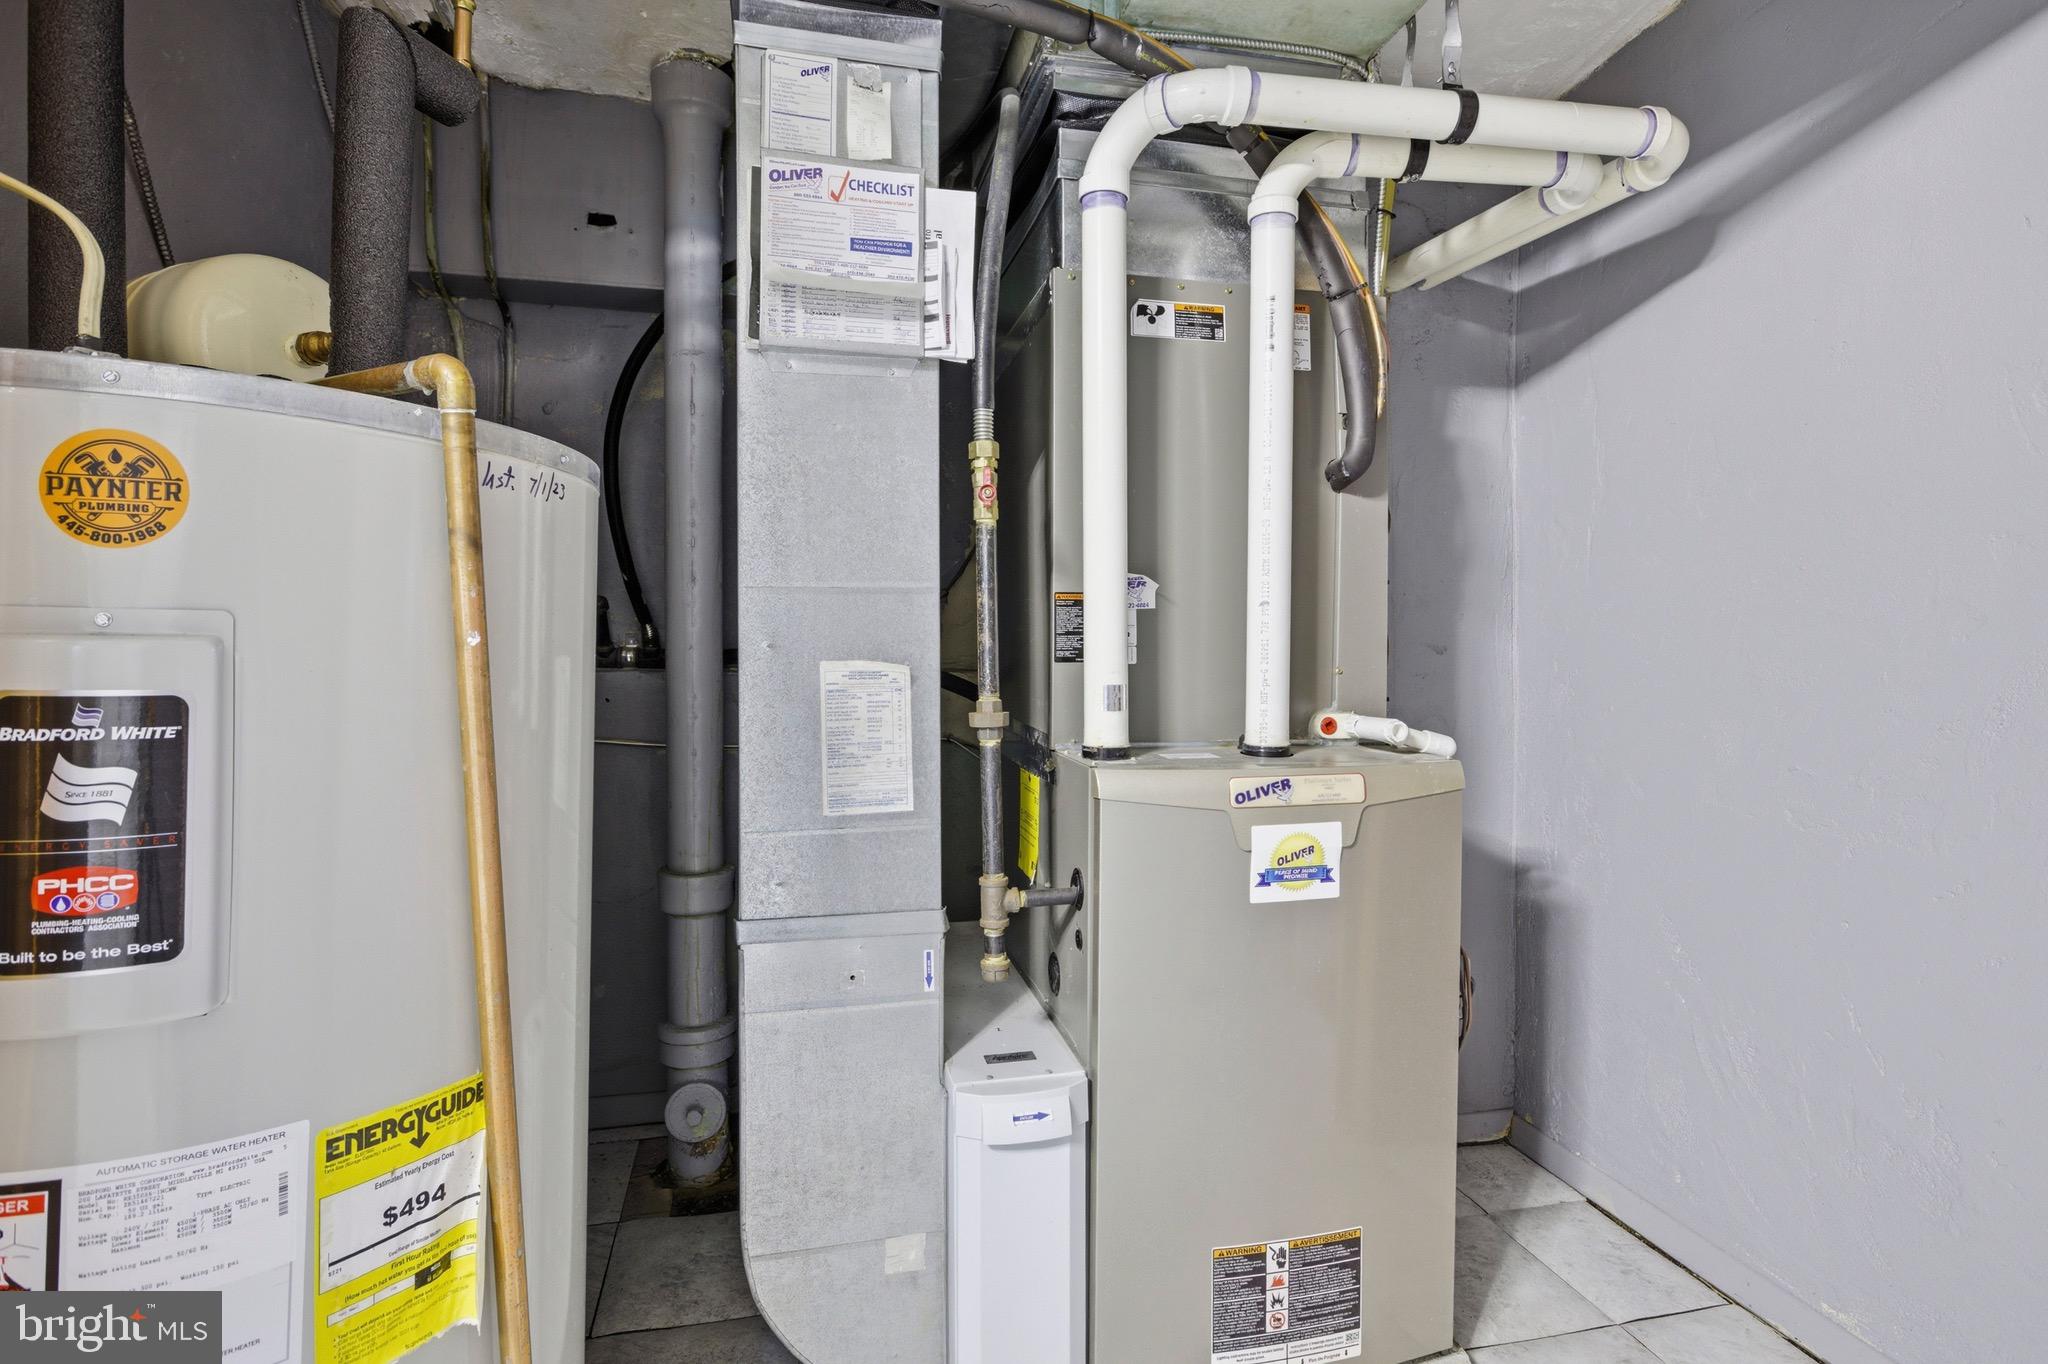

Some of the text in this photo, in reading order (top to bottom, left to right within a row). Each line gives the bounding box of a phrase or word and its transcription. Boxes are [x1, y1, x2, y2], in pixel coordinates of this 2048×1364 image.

[800, 65, 830, 77] OLIVER
[768, 167, 915, 197] OLIVER CHECKLIST
[45, 474, 182, 502] PAYNTER
[530, 472, 565, 502] 7/1/23
[79, 501, 150, 513] PLUMBING
[57, 514, 167, 544] 445-800-1968
[0, 726, 178, 742] BRADFORD WHITE
[91, 790, 114, 798] 1881
[1235, 778, 1292, 805] OLIVER
[1277, 845, 1315, 866] OLIVER
[38, 874, 135, 895] PHCC
[31, 914, 140, 928] PLUMBING-HEATING-COOLING
[31, 921, 137, 936] CONTRACTORS ASSOCIATION
[0, 940, 170, 964] Built to be the Best
[325, 1081, 484, 1162] ENERGYGUIDE
[96, 1130, 286, 1176] AUTOMATIC STORAGE WATER HEATER
[375, 1150, 455, 1190] Estimated Yearly Energy Cost
[382, 1183, 446, 1228] $494
[1225, 1230, 1358, 1256] WARNING AVERTISSEMENT
[391, 1258, 405, 1270] First
[406, 1250, 422, 1263] Hour
[388, 1272, 404, 1283] water
[405, 1266, 416, 1276] you
[235, 1339, 261, 1352] HEATER
